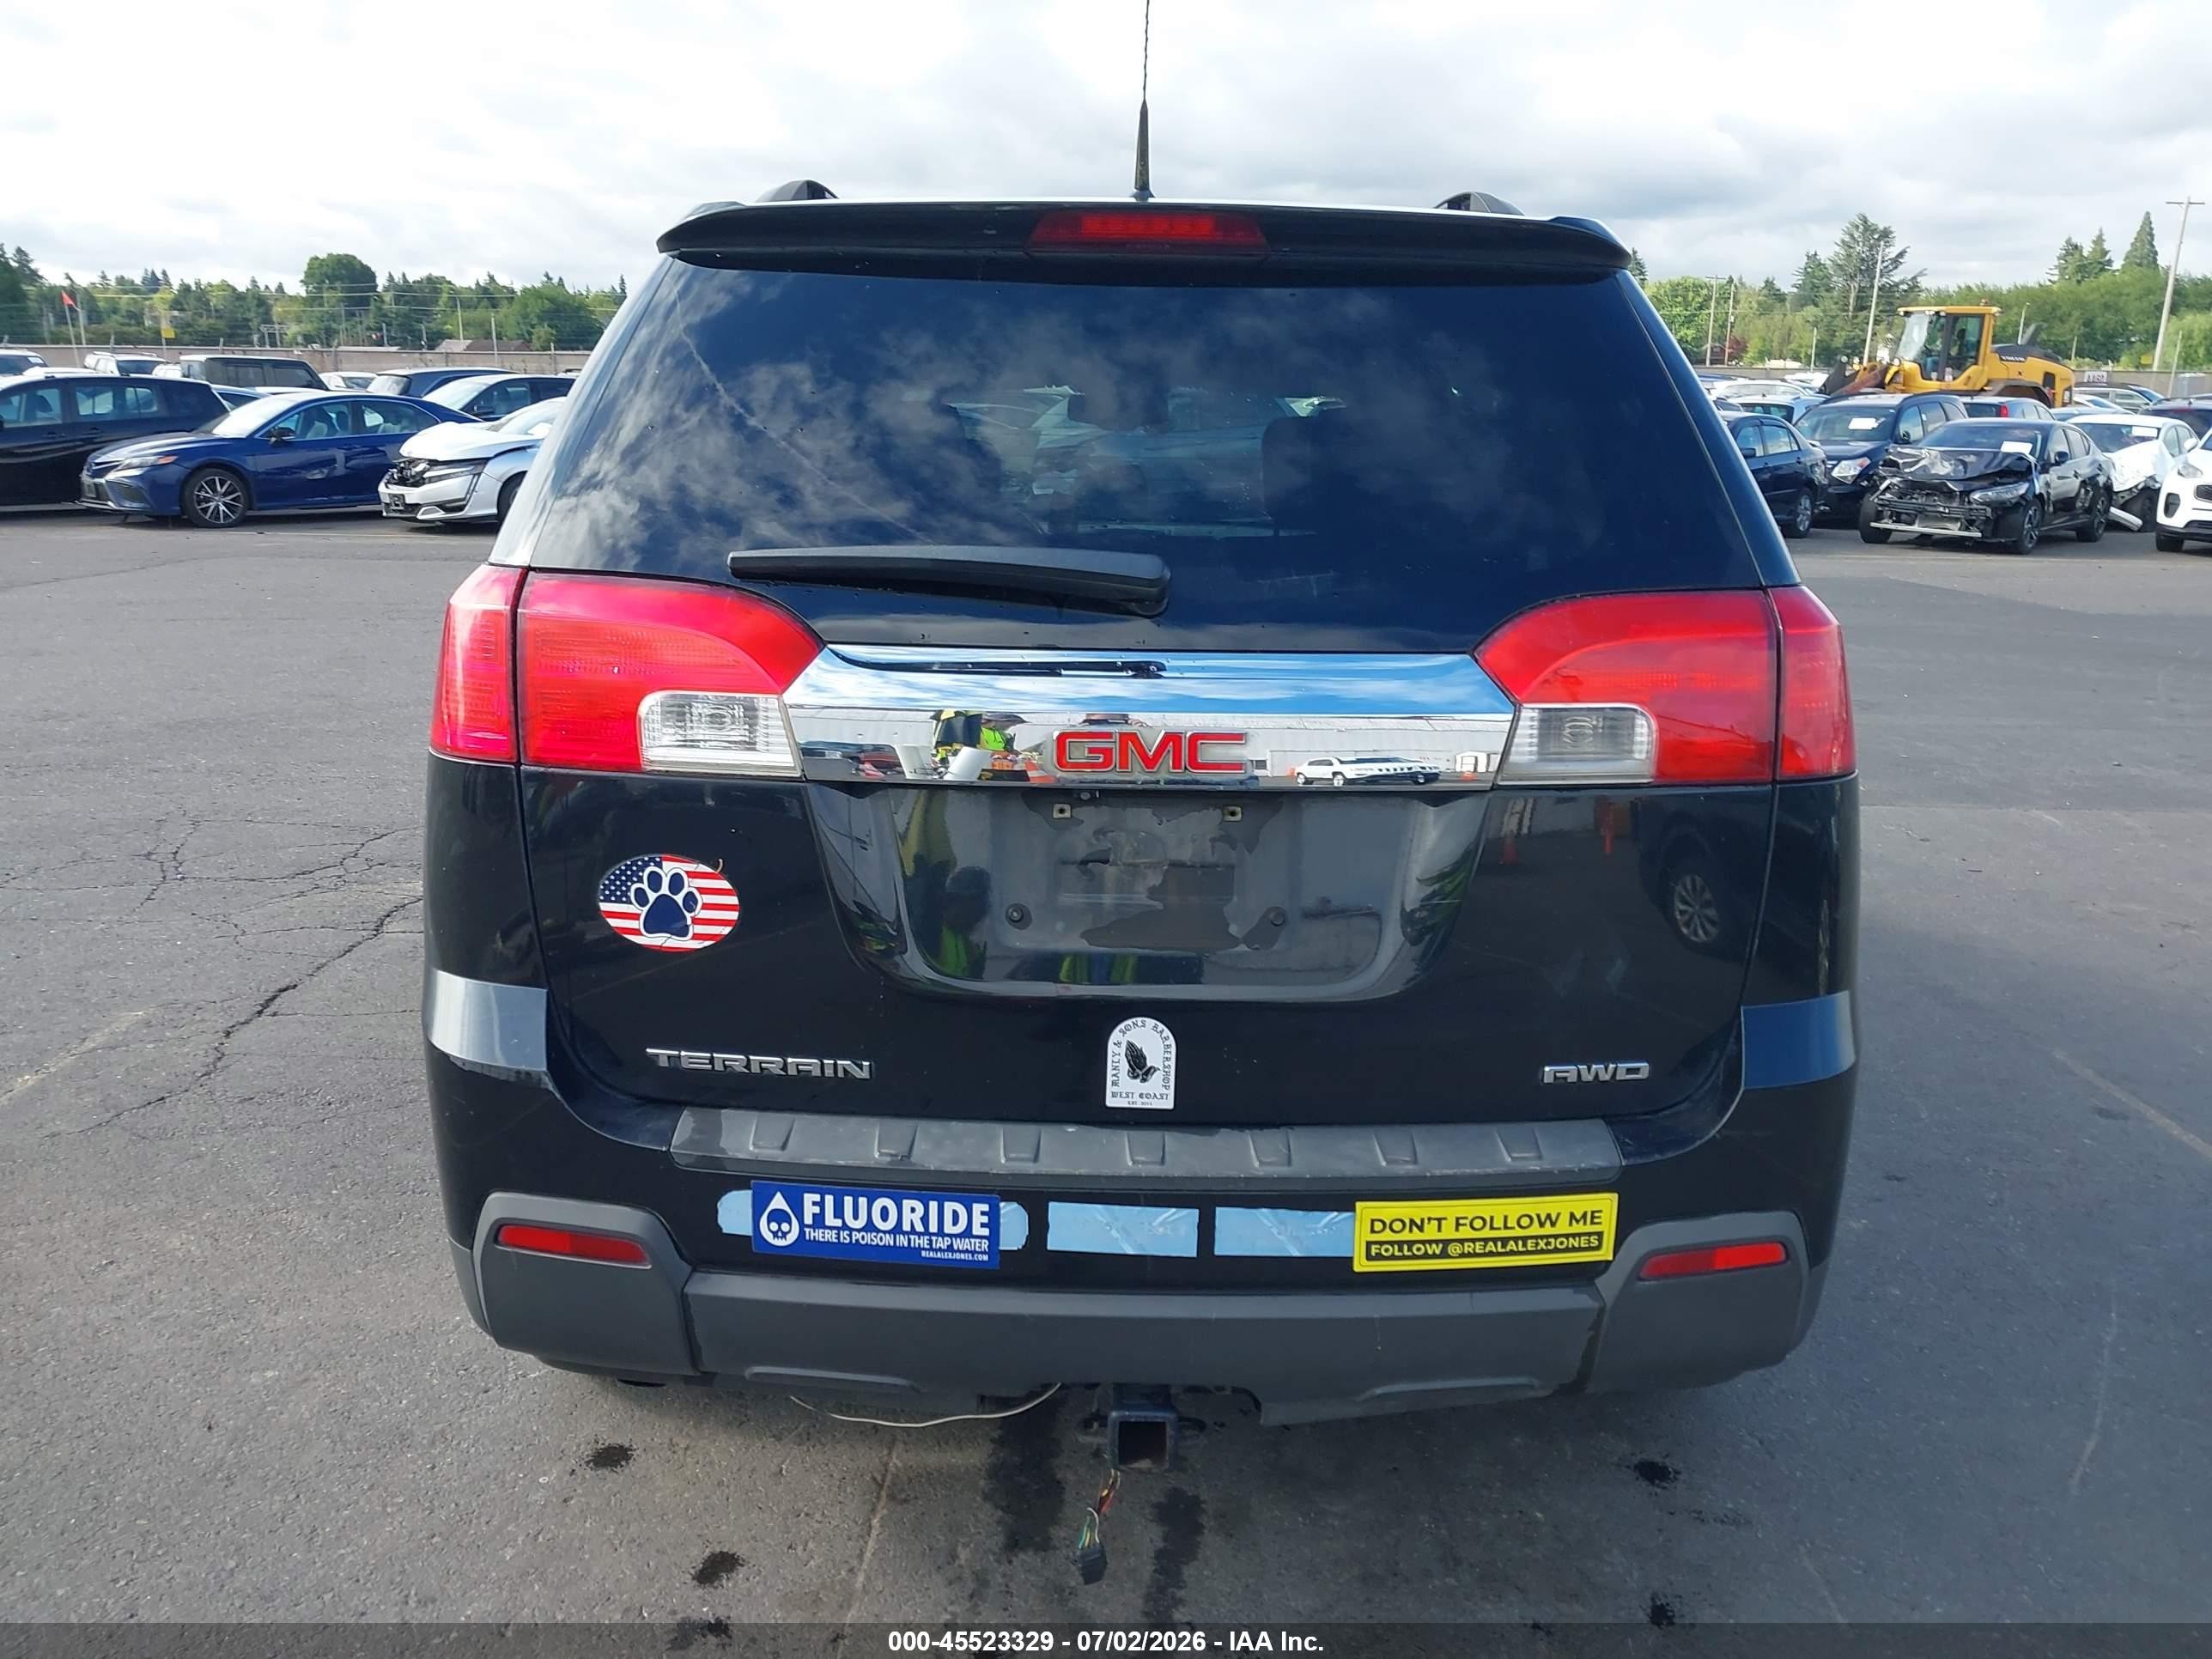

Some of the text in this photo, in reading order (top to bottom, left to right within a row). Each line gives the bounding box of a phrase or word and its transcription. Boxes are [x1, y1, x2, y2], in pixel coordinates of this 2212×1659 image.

[1054, 730, 1246, 774] GMC
[646, 1048, 871, 1079] TERRAIN
[1544, 1062, 1650, 1083] AWD
[1139, 1091, 1170, 1100] COAST
[803, 1193, 990, 1236] FLUORIDE
[1370, 1210, 1603, 1234] DON'T FOLLOW ME
[804, 1228, 989, 1252] THERE IS POISON IN THE TAP WATER
[1370, 1235, 1599, 1256] FOLLOW @REALALEXJONES
[921, 1250, 989, 1261] REALALEXJONES.COM
